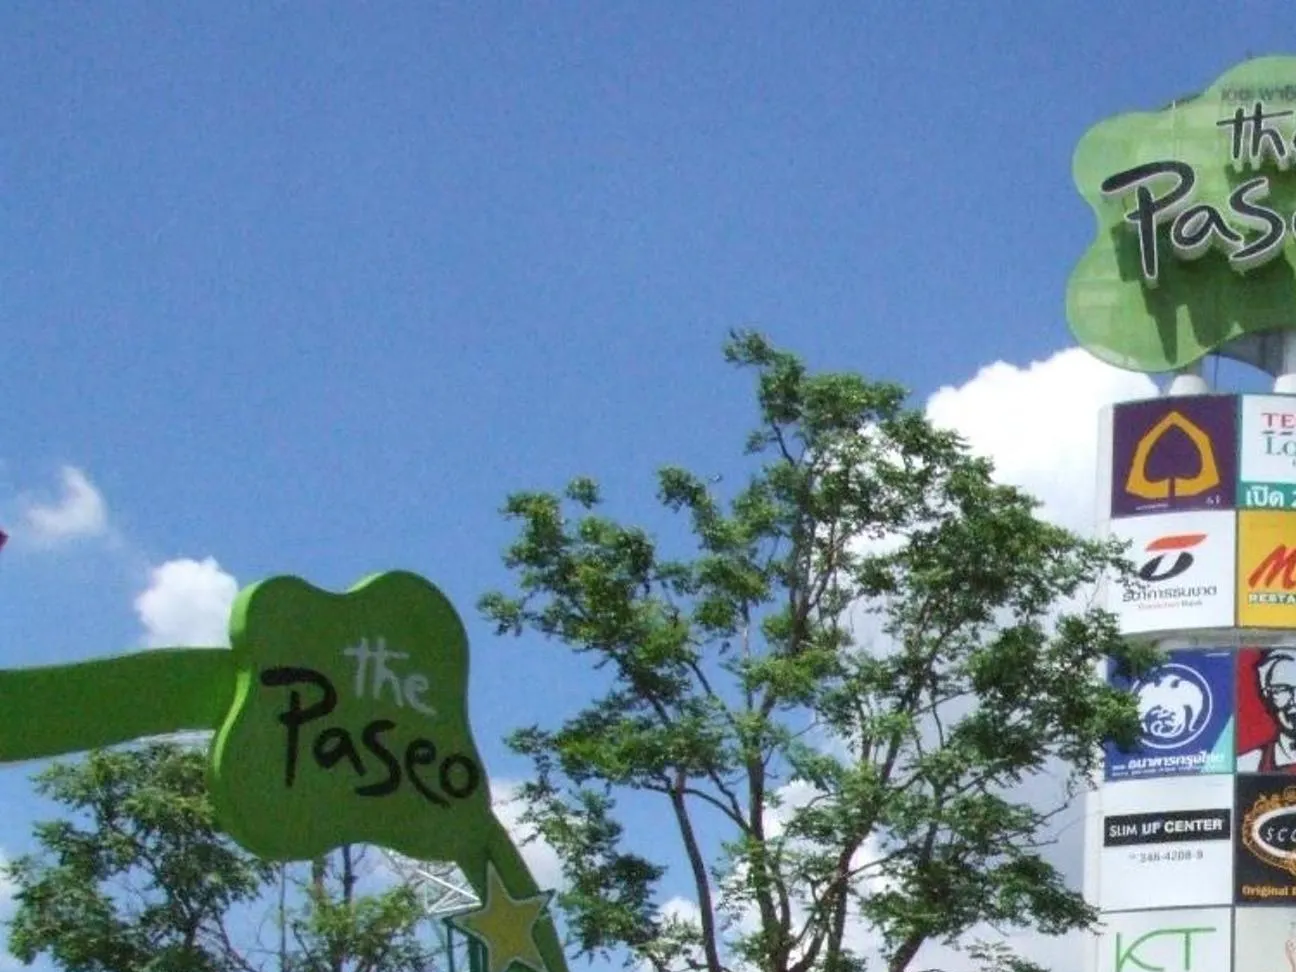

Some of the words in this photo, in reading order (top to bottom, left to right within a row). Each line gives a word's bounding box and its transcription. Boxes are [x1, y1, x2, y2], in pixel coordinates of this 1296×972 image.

[1246, 485, 1285, 507] เปิด
[344, 637, 437, 716] the
[260, 666, 480, 808] Paseo
[1109, 824, 1137, 837] SLIM
[1142, 821, 1161, 834] UP
[1164, 818, 1223, 833] CENTER
[1242, 884, 1288, 897] Original
